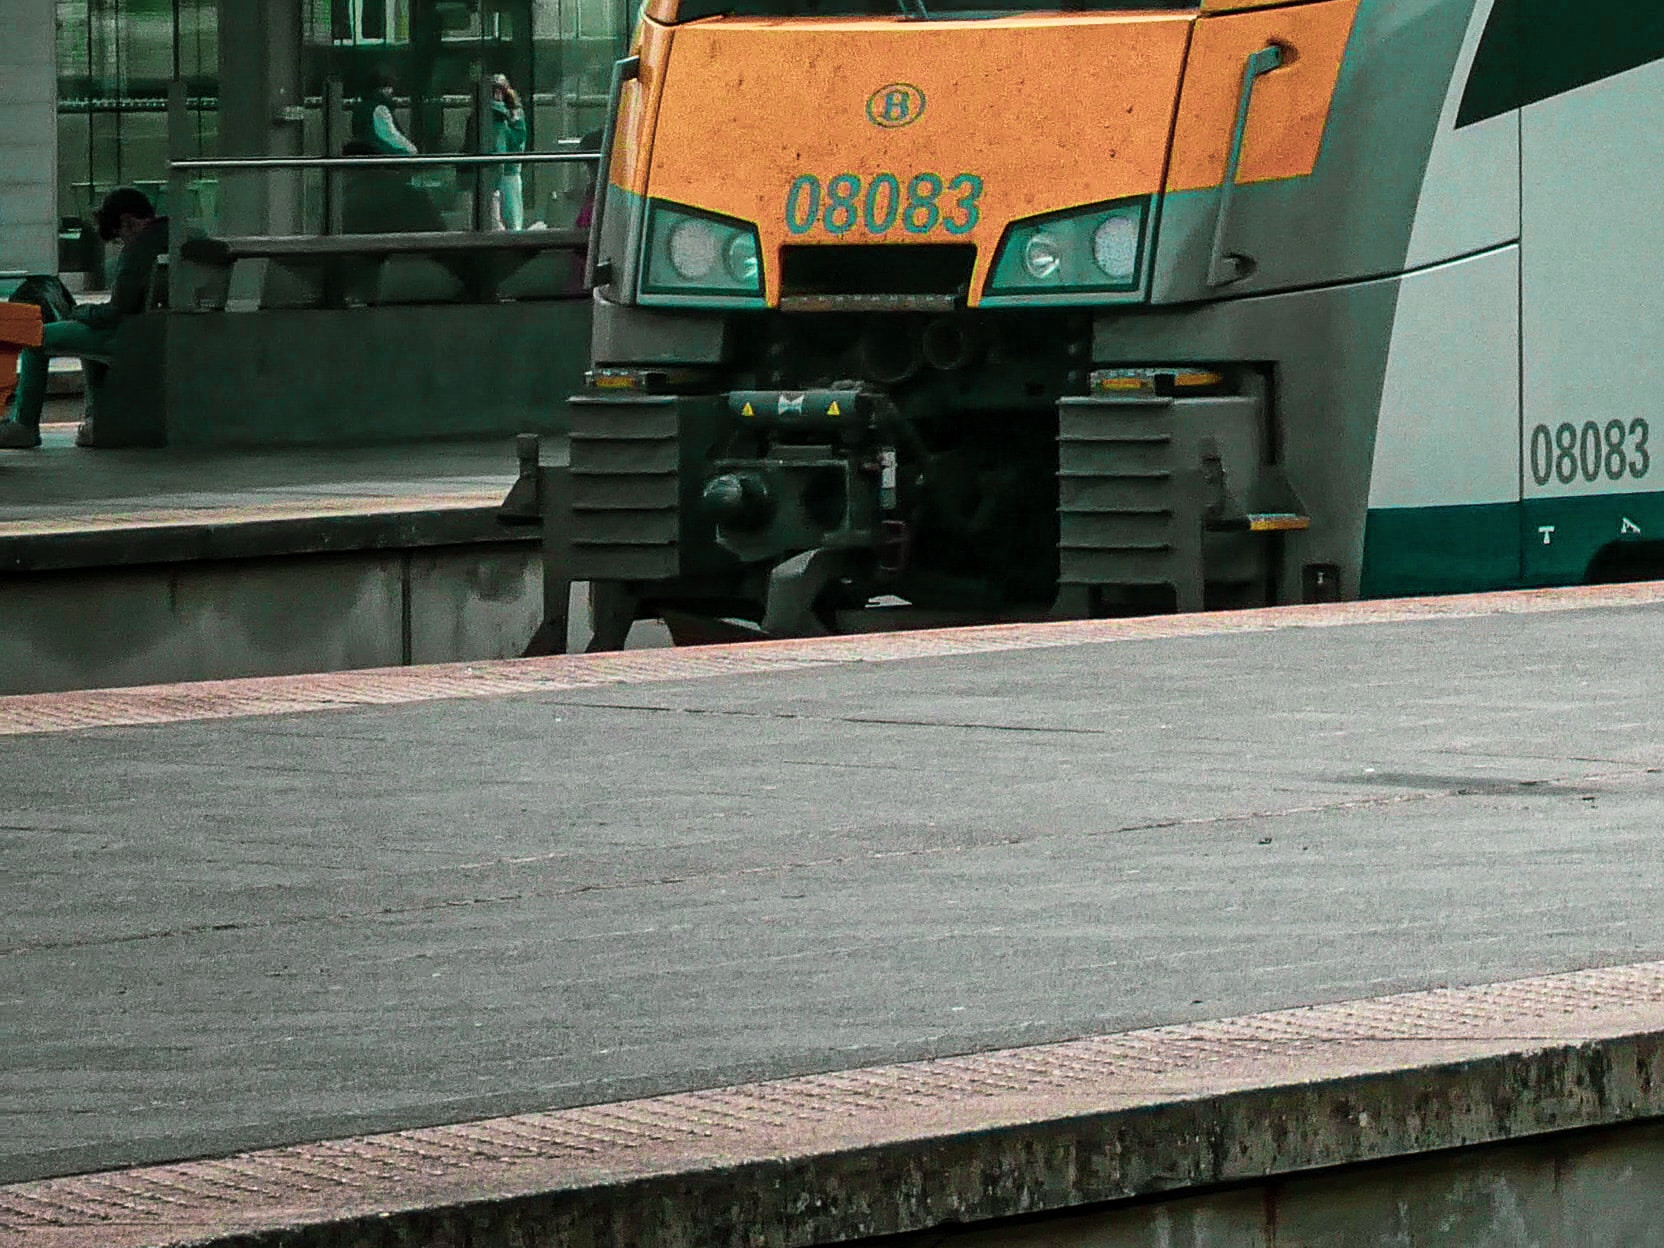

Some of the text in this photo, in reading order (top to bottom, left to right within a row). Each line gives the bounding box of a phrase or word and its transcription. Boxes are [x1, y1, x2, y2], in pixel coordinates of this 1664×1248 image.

[881, 91, 910, 122] B
[785, 172, 984, 235] 08083
[1530, 417, 1650, 486] 08083
